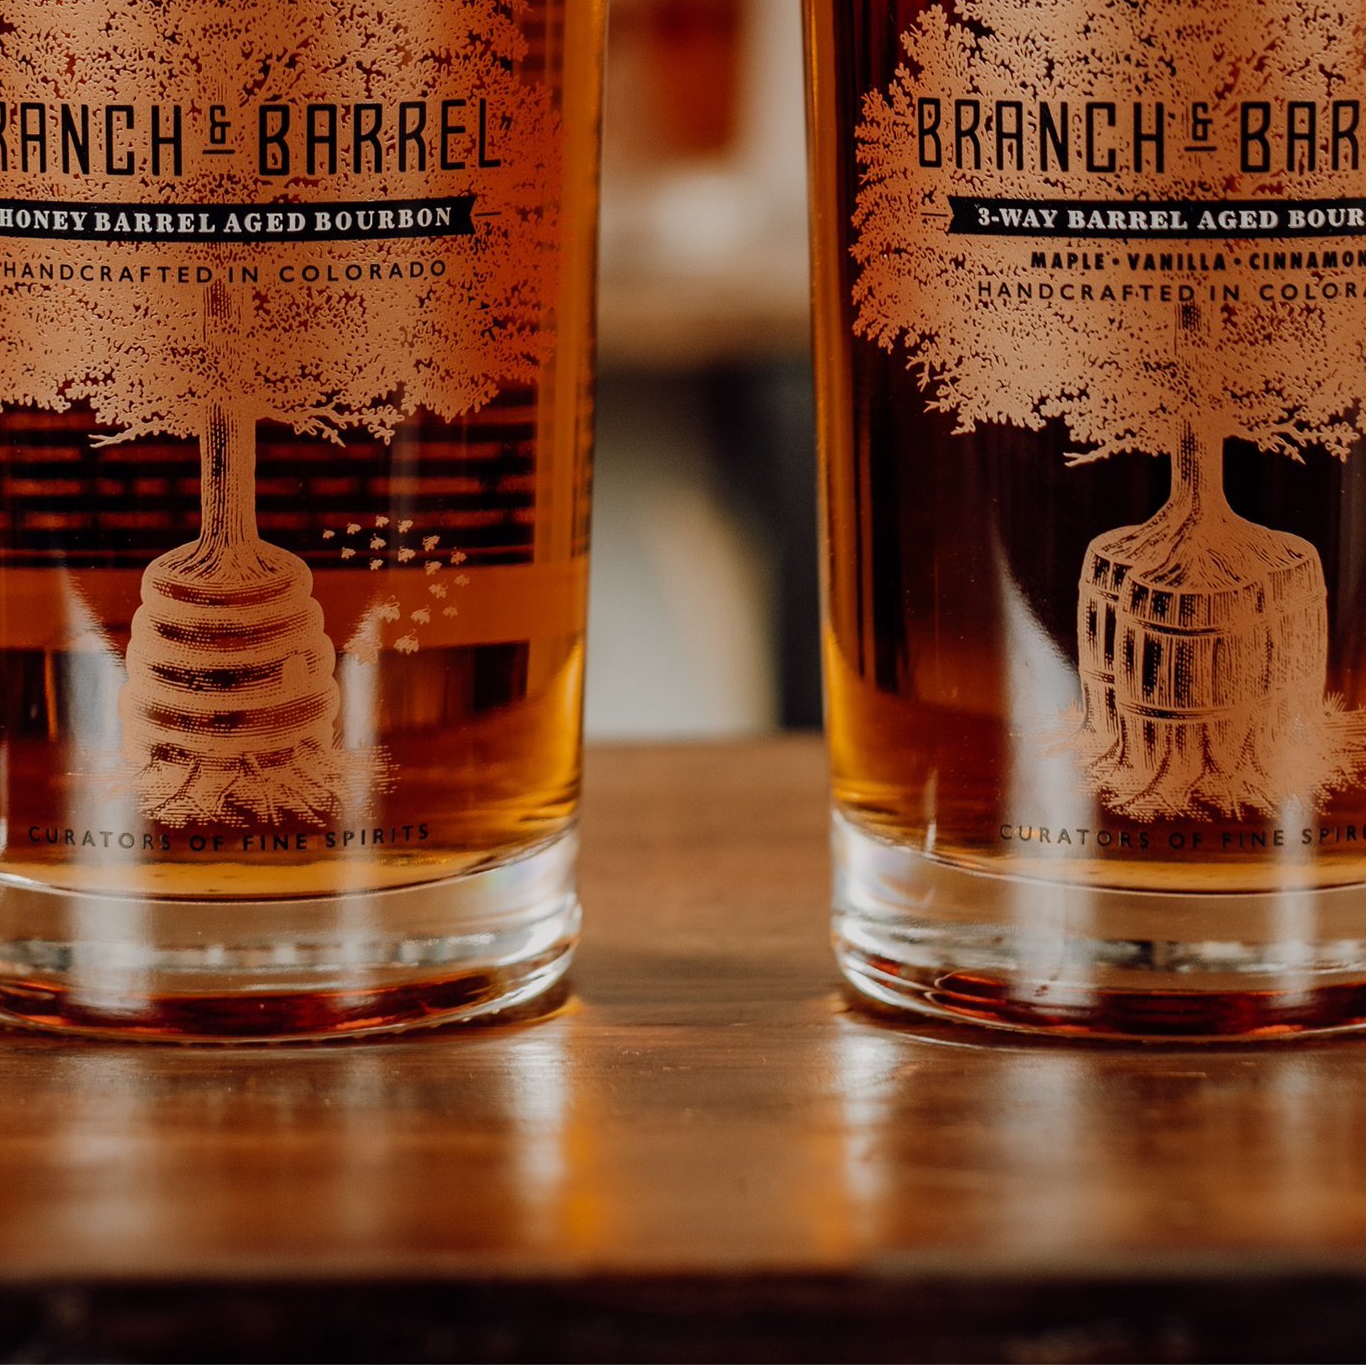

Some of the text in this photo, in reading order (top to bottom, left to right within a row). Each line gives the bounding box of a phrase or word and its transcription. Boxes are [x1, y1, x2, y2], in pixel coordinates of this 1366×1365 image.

[202, 105, 236, 154] &
[258, 97, 502, 176] BARREL
[917, 96, 1166, 174] BRANCH
[1183, 103, 1218, 152] &
[94, 211, 215, 233] BARREL
[224, 211, 306, 233] AGED
[314, 206, 453, 232] BOURBON
[977, 205, 1058, 230] 3-WAY
[1067, 209, 1188, 232] BARREL
[1197, 209, 1278, 231] AGED
[2, 259, 448, 284] HANDCRAFTED IN COLORADO
[1030, 250, 1106, 271] MAPLE
[1126, 251, 1227, 272] VANILLA
[977, 280, 1195, 303] HANDCRAFTED
[1208, 283, 1240, 303] IN
[28, 823, 430, 852] CURATORS OF FINE SPIRITS
[999, 823, 1150, 850] CURATORS
[1168, 833, 1203, 850] OF
[1222, 830, 1284, 849] FINE
